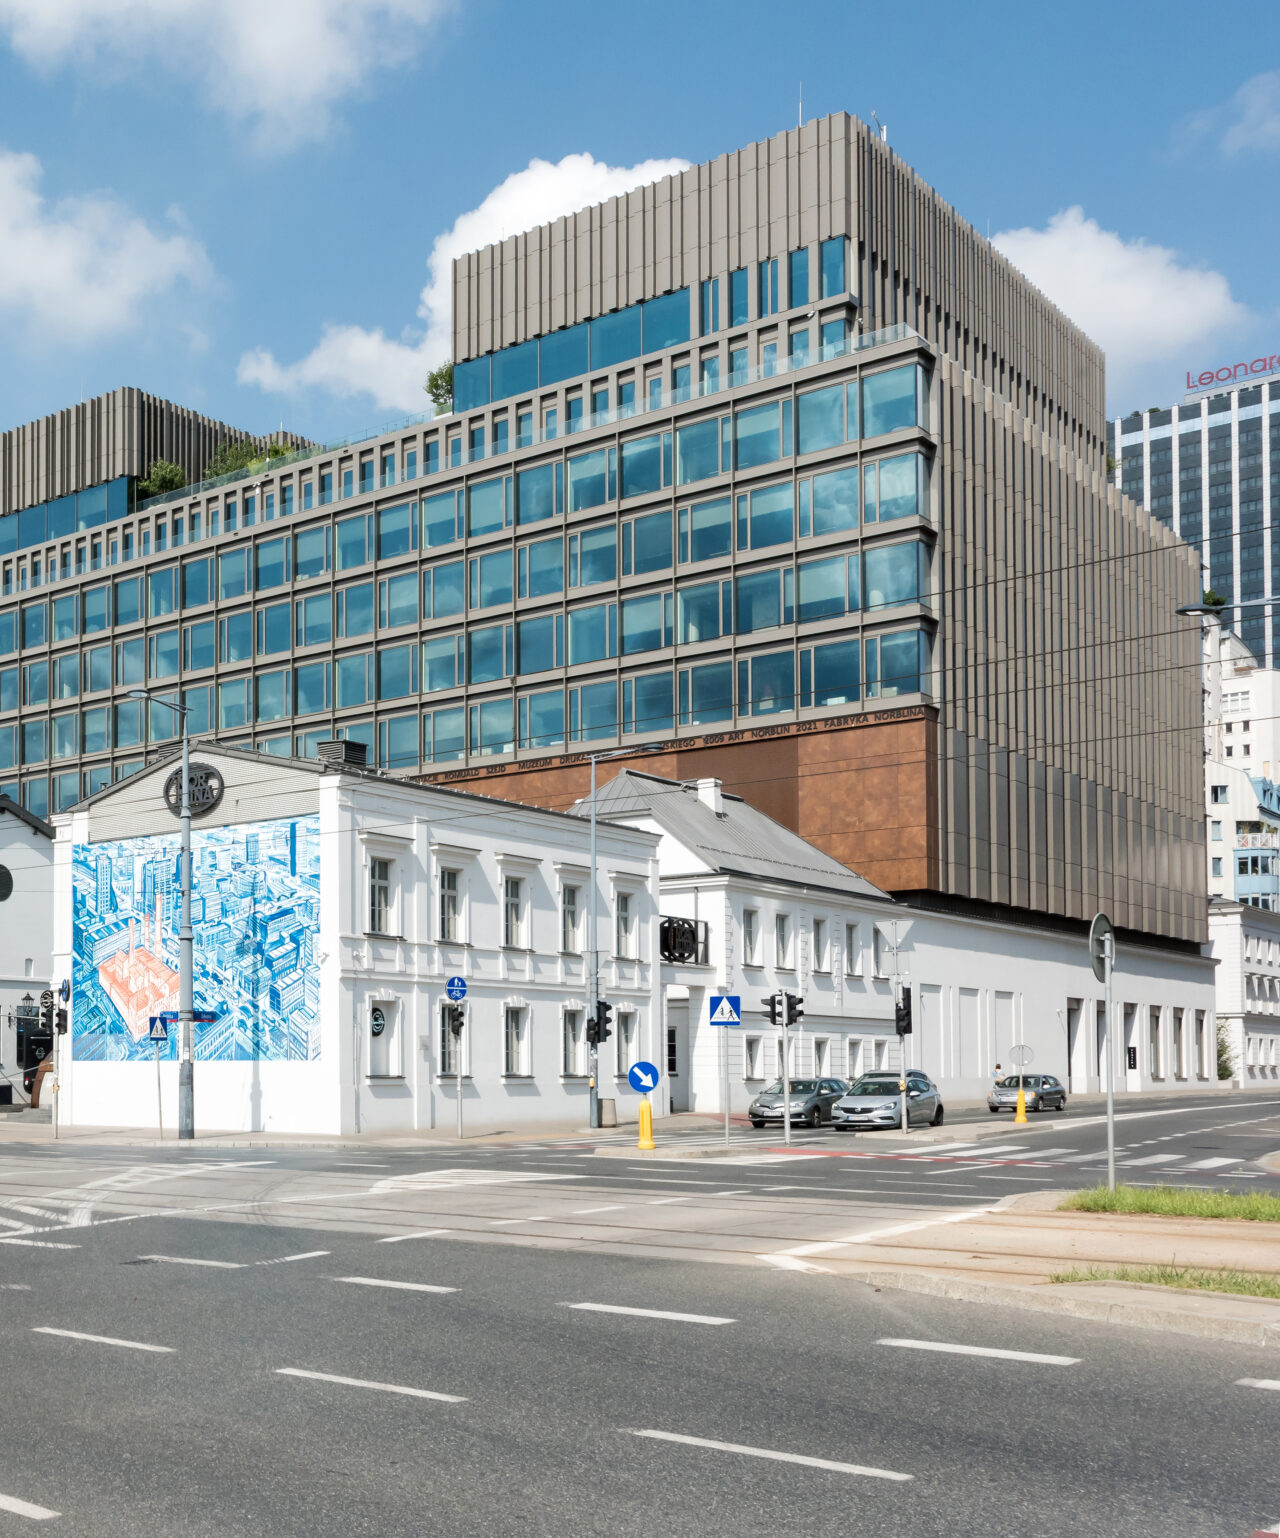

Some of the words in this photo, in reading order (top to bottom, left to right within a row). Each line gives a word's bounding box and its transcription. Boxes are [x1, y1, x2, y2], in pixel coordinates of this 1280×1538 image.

[1186, 354, 1280, 389] Leonar
[486, 765, 506, 775] SZEJD
[518, 757, 553, 770] MUZEUM
[728, 731, 745, 742] ART
[751, 724, 791, 739] NORBLIN
[796, 720, 818, 732] 2021
[823, 714, 869, 729] FABRYKA
[874, 706, 925, 722] NORBLINA
